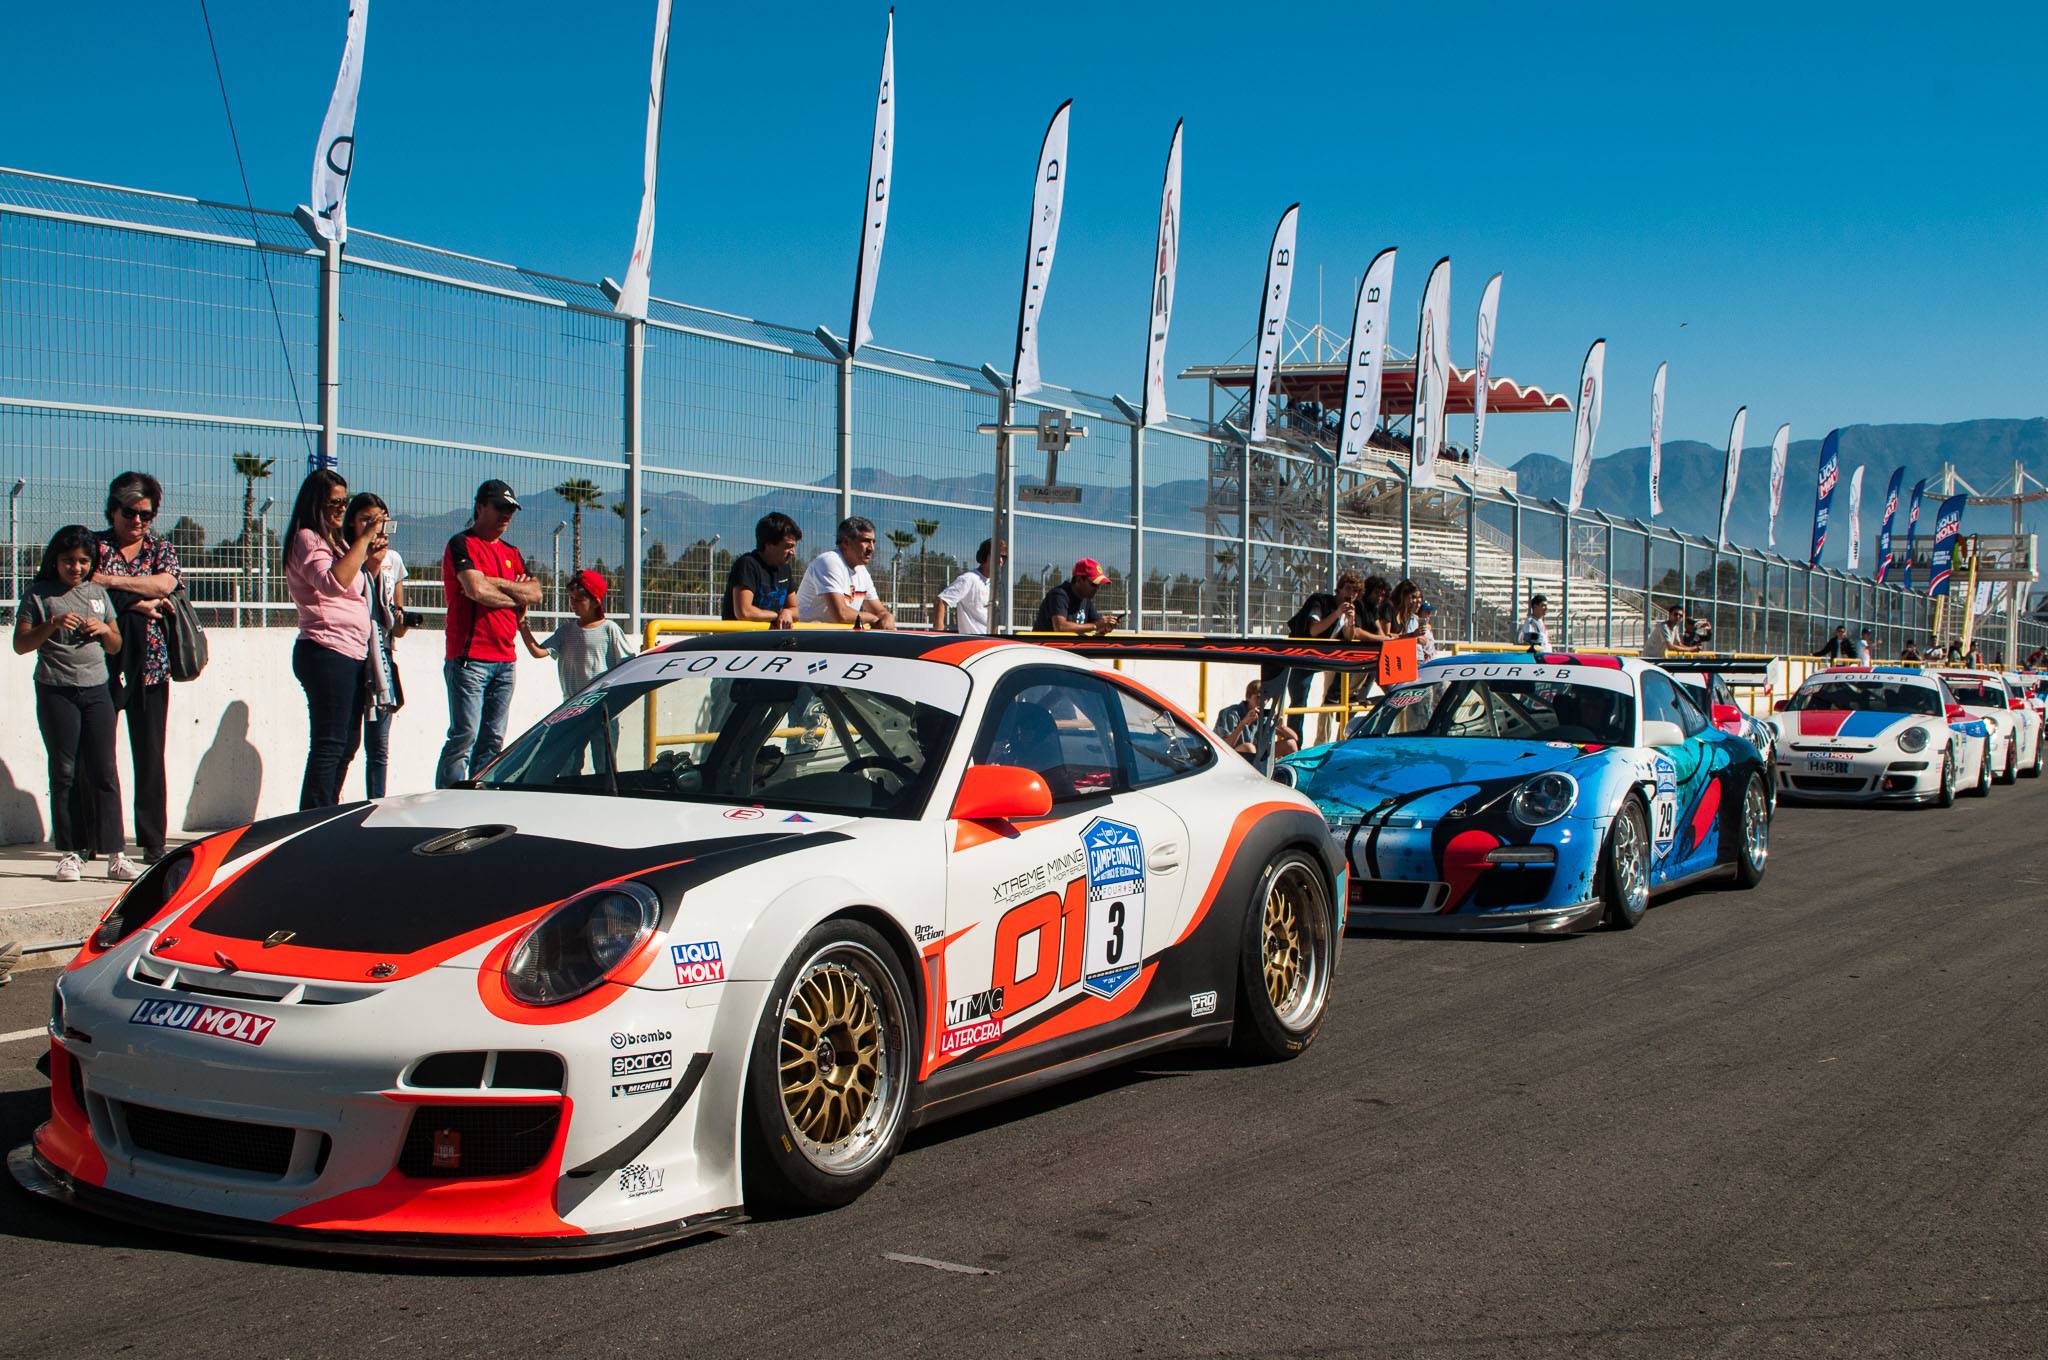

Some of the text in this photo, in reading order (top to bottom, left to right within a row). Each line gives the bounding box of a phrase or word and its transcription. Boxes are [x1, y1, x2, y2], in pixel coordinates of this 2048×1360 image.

[1346, 286, 1381, 455] FOUR B
[656, 655, 874, 680] FOUR B
[1440, 666, 1572, 679] FOUR B
[1659, 802, 1673, 838] 29
[993, 848, 1084, 900] XTREME MINING
[1091, 844, 1141, 879] CAMPEONATO
[1106, 901, 1126, 965] 3
[673, 943, 720, 964] LIQUI
[677, 961, 722, 984] MOLY
[1193, 994, 1215, 1009] PRO
[132, 1000, 273, 1041] LIQUI MOLY
[628, 1029, 672, 1045] brembo
[613, 1052, 671, 1075] sparco
[628, 1080, 670, 1092] MICHELIN
[628, 1168, 665, 1193] KW
